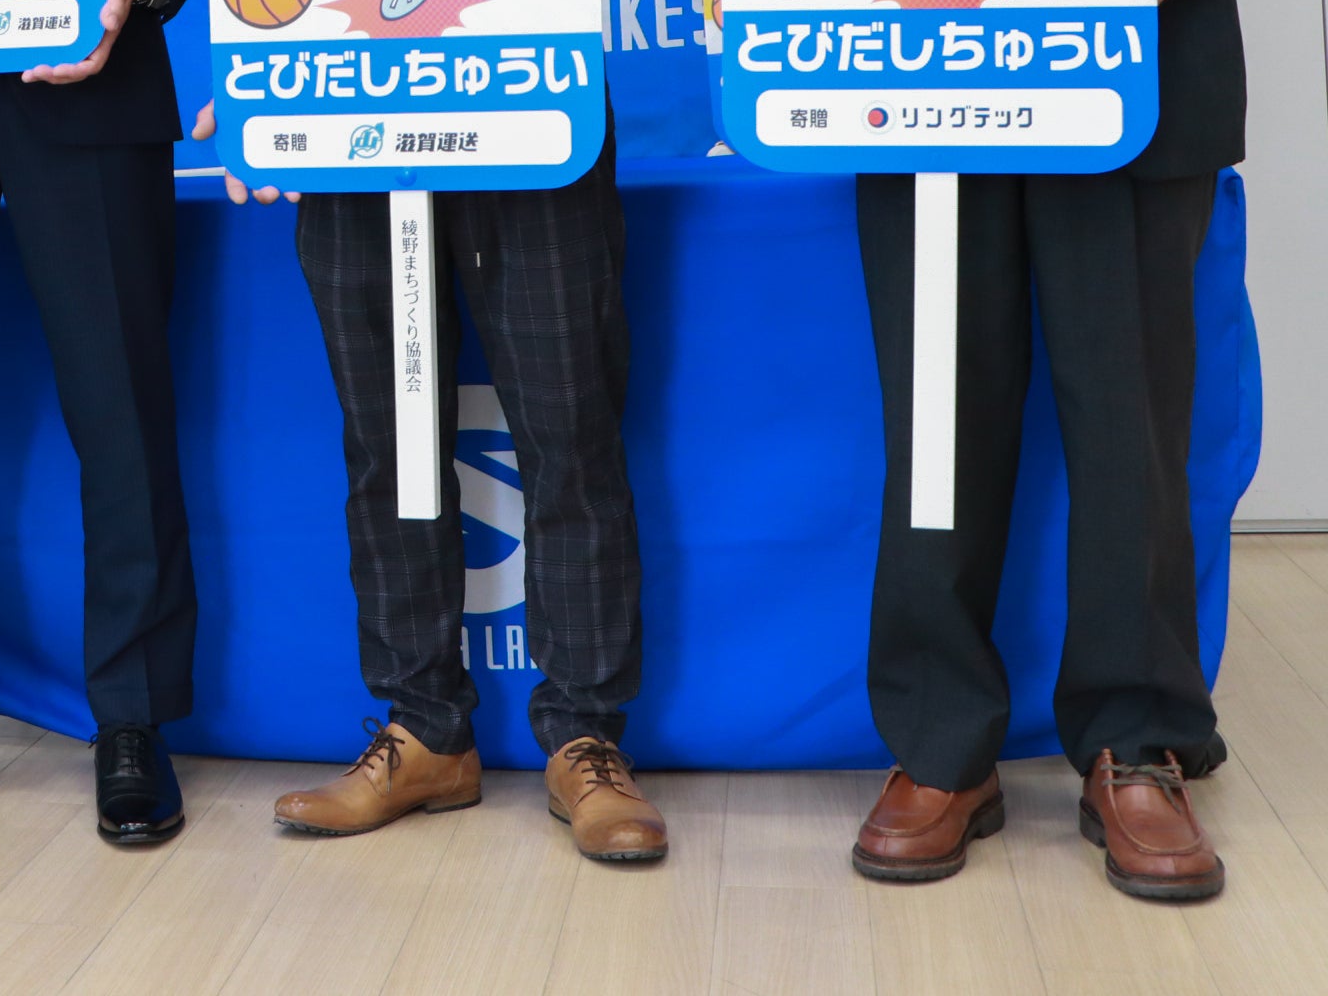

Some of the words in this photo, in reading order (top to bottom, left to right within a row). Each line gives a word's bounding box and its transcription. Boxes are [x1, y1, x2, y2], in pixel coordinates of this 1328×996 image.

[18, 15, 71, 31] 滋賀運送
[737, 21, 1143, 72] とびだしちゅうい
[225, 47, 588, 100] とびだしちゅうい
[790, 108, 828, 128] 寄贈
[902, 105, 1034, 128] リングテック
[273, 133, 307, 152] 寄贈
[395, 131, 479, 153] 滋賀運送
[402, 220, 422, 393] 綾野まちづくり協議会
